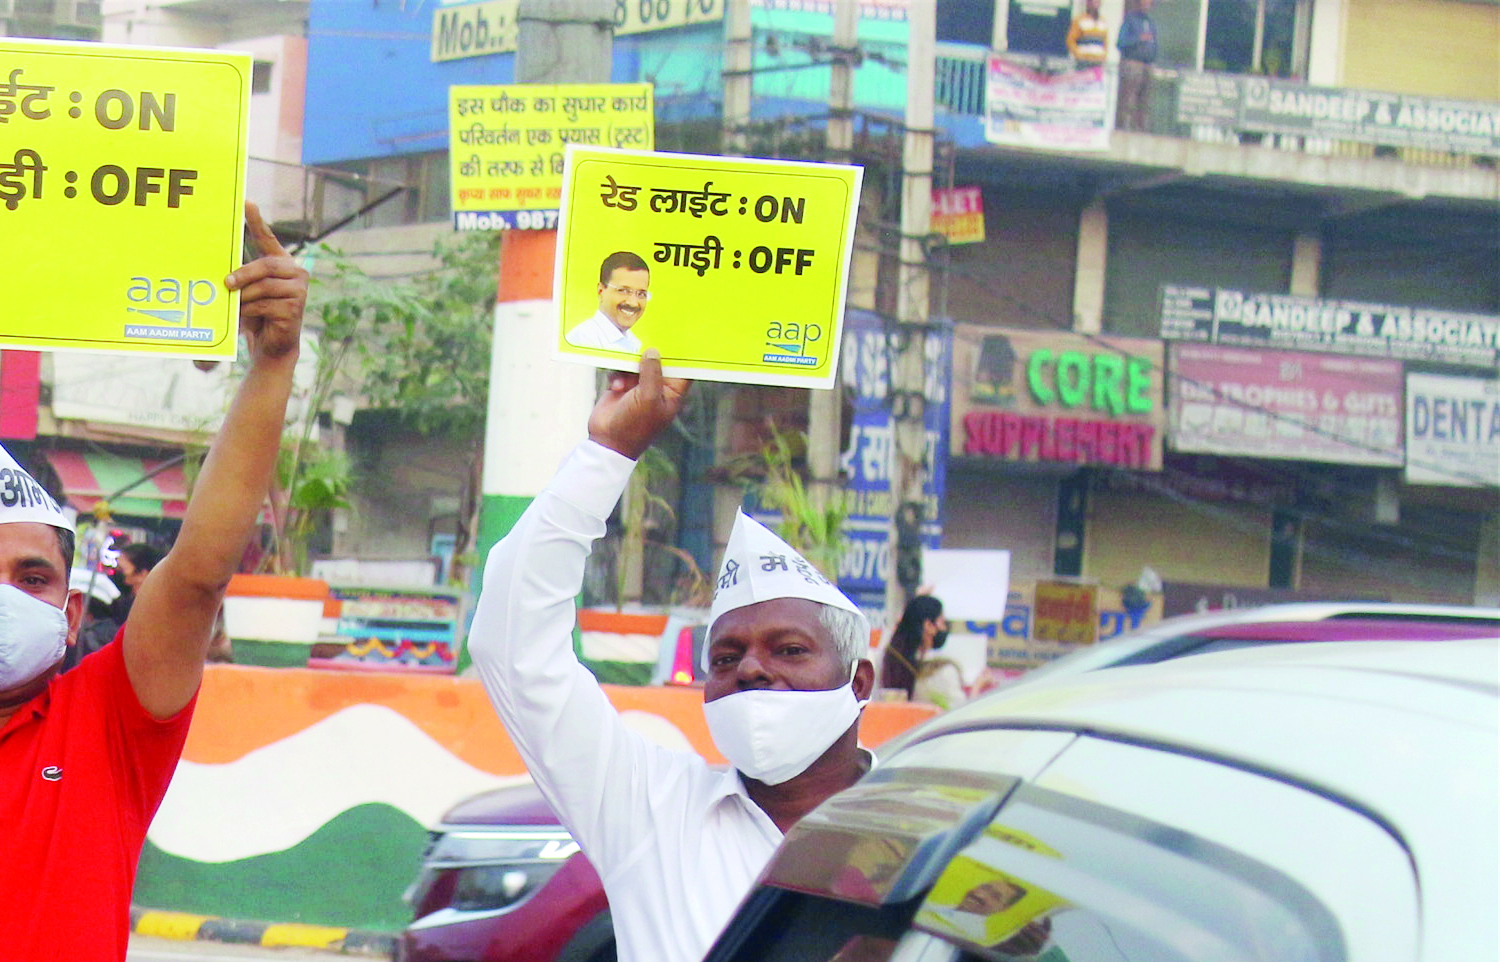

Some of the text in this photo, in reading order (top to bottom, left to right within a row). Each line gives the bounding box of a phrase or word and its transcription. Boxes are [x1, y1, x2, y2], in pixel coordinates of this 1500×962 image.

[94, 89, 176, 133] ON
[457, 97, 484, 116] इस
[533, 97, 556, 113] का
[526, 128, 553, 146] एक
[460, 153, 481, 177] की
[530, 153, 544, 177] से
[90, 164, 198, 209] OFF
[600, 175, 642, 211] रेड
[650, 182, 731, 218] लाईट
[754, 195, 806, 225] ON
[457, 211, 511, 231] Mob.
[653, 235, 724, 277] गाड़ी
[749, 246, 815, 276] OFF
[126, 277, 217, 328] aap
[126, 327, 212, 339] AAM AADMI PARTY
[766, 321, 822, 356] aap
[1026, 348, 1154, 416] CORE
[962, 411, 1156, 471] SUPPLEMENT
